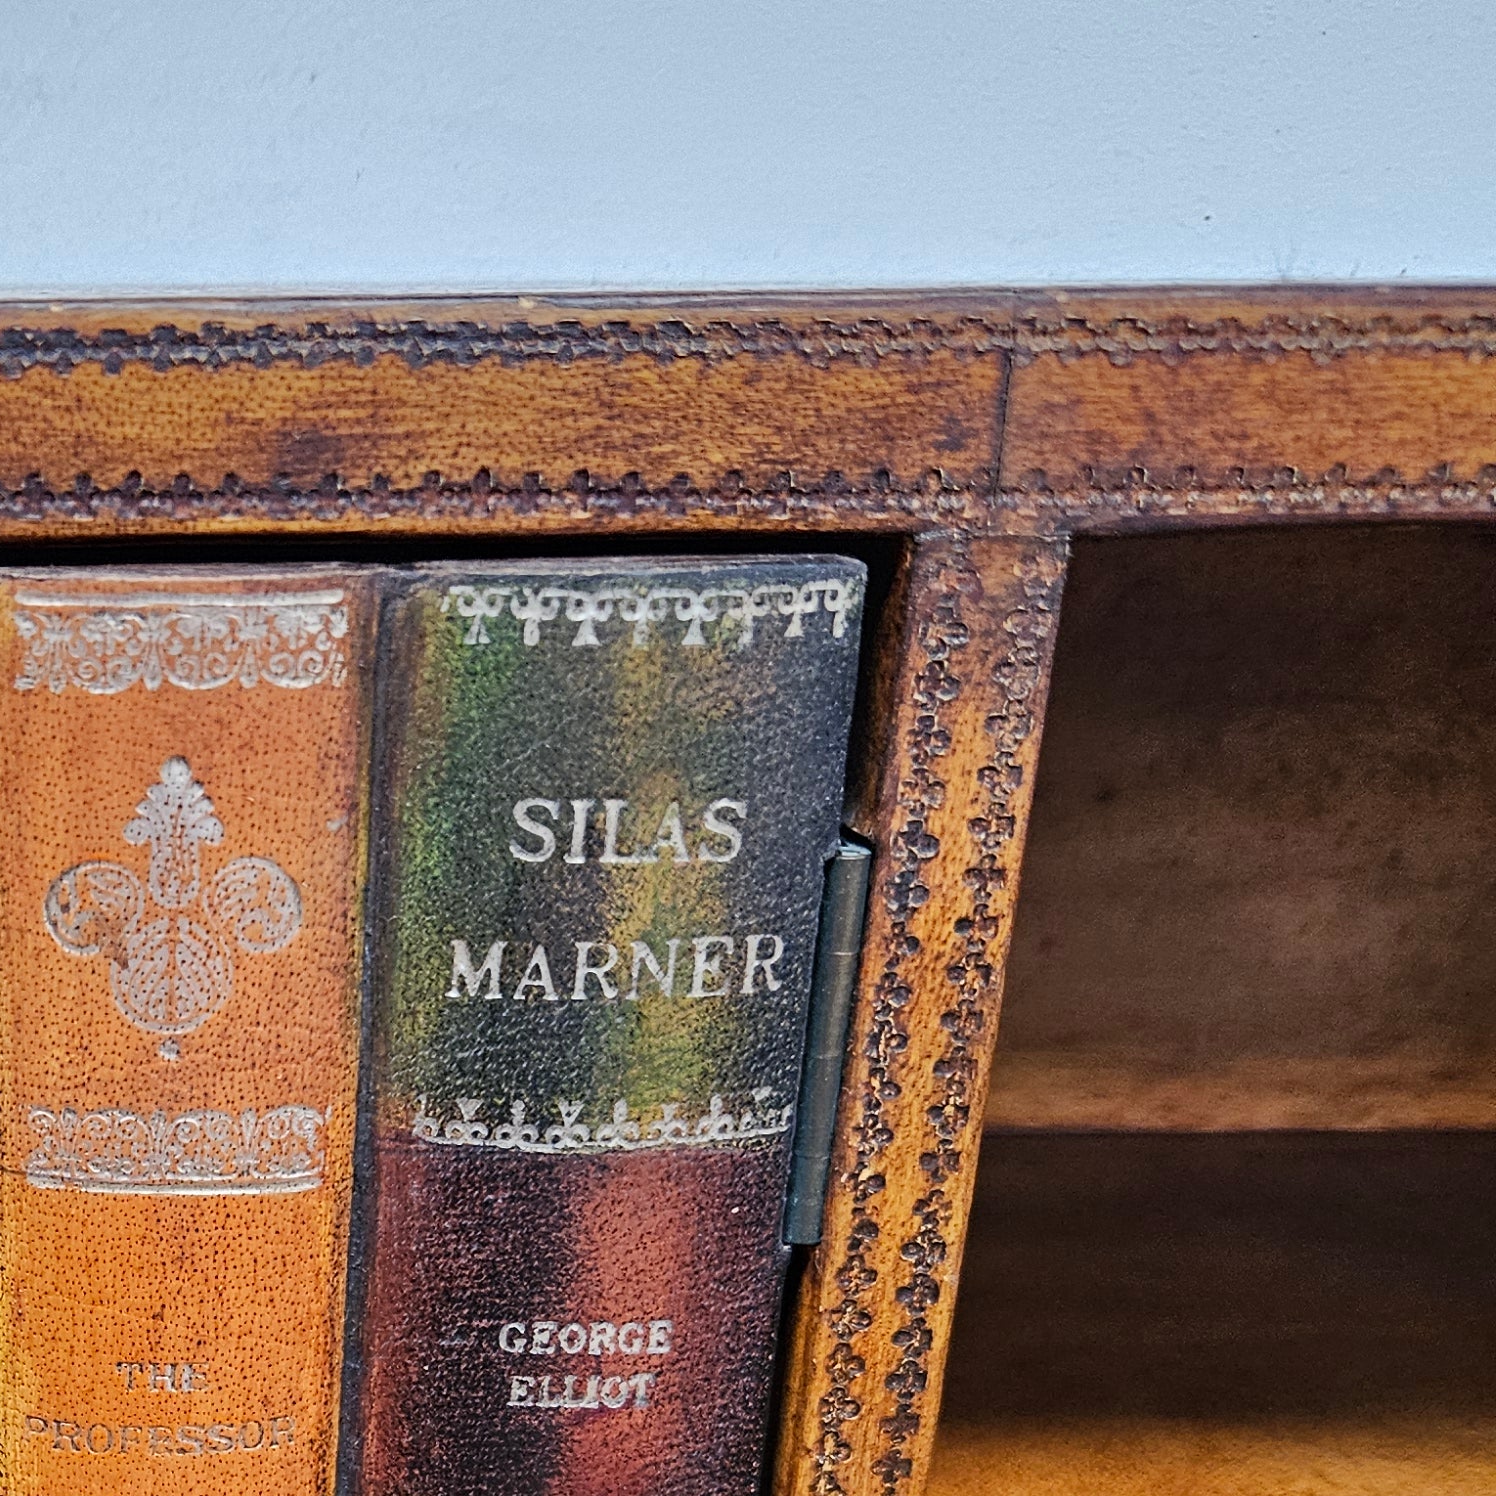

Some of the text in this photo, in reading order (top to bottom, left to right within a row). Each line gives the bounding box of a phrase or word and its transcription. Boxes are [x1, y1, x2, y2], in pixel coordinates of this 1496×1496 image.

[508, 798, 747, 864] SILAS
[445, 934, 785, 1001] MARNER
[498, 1319, 674, 1355] GEORGE
[116, 1361, 210, 1393] THE
[506, 1373, 656, 1409] ELLIOT
[25, 1413, 296, 1455] PROFESSOR
